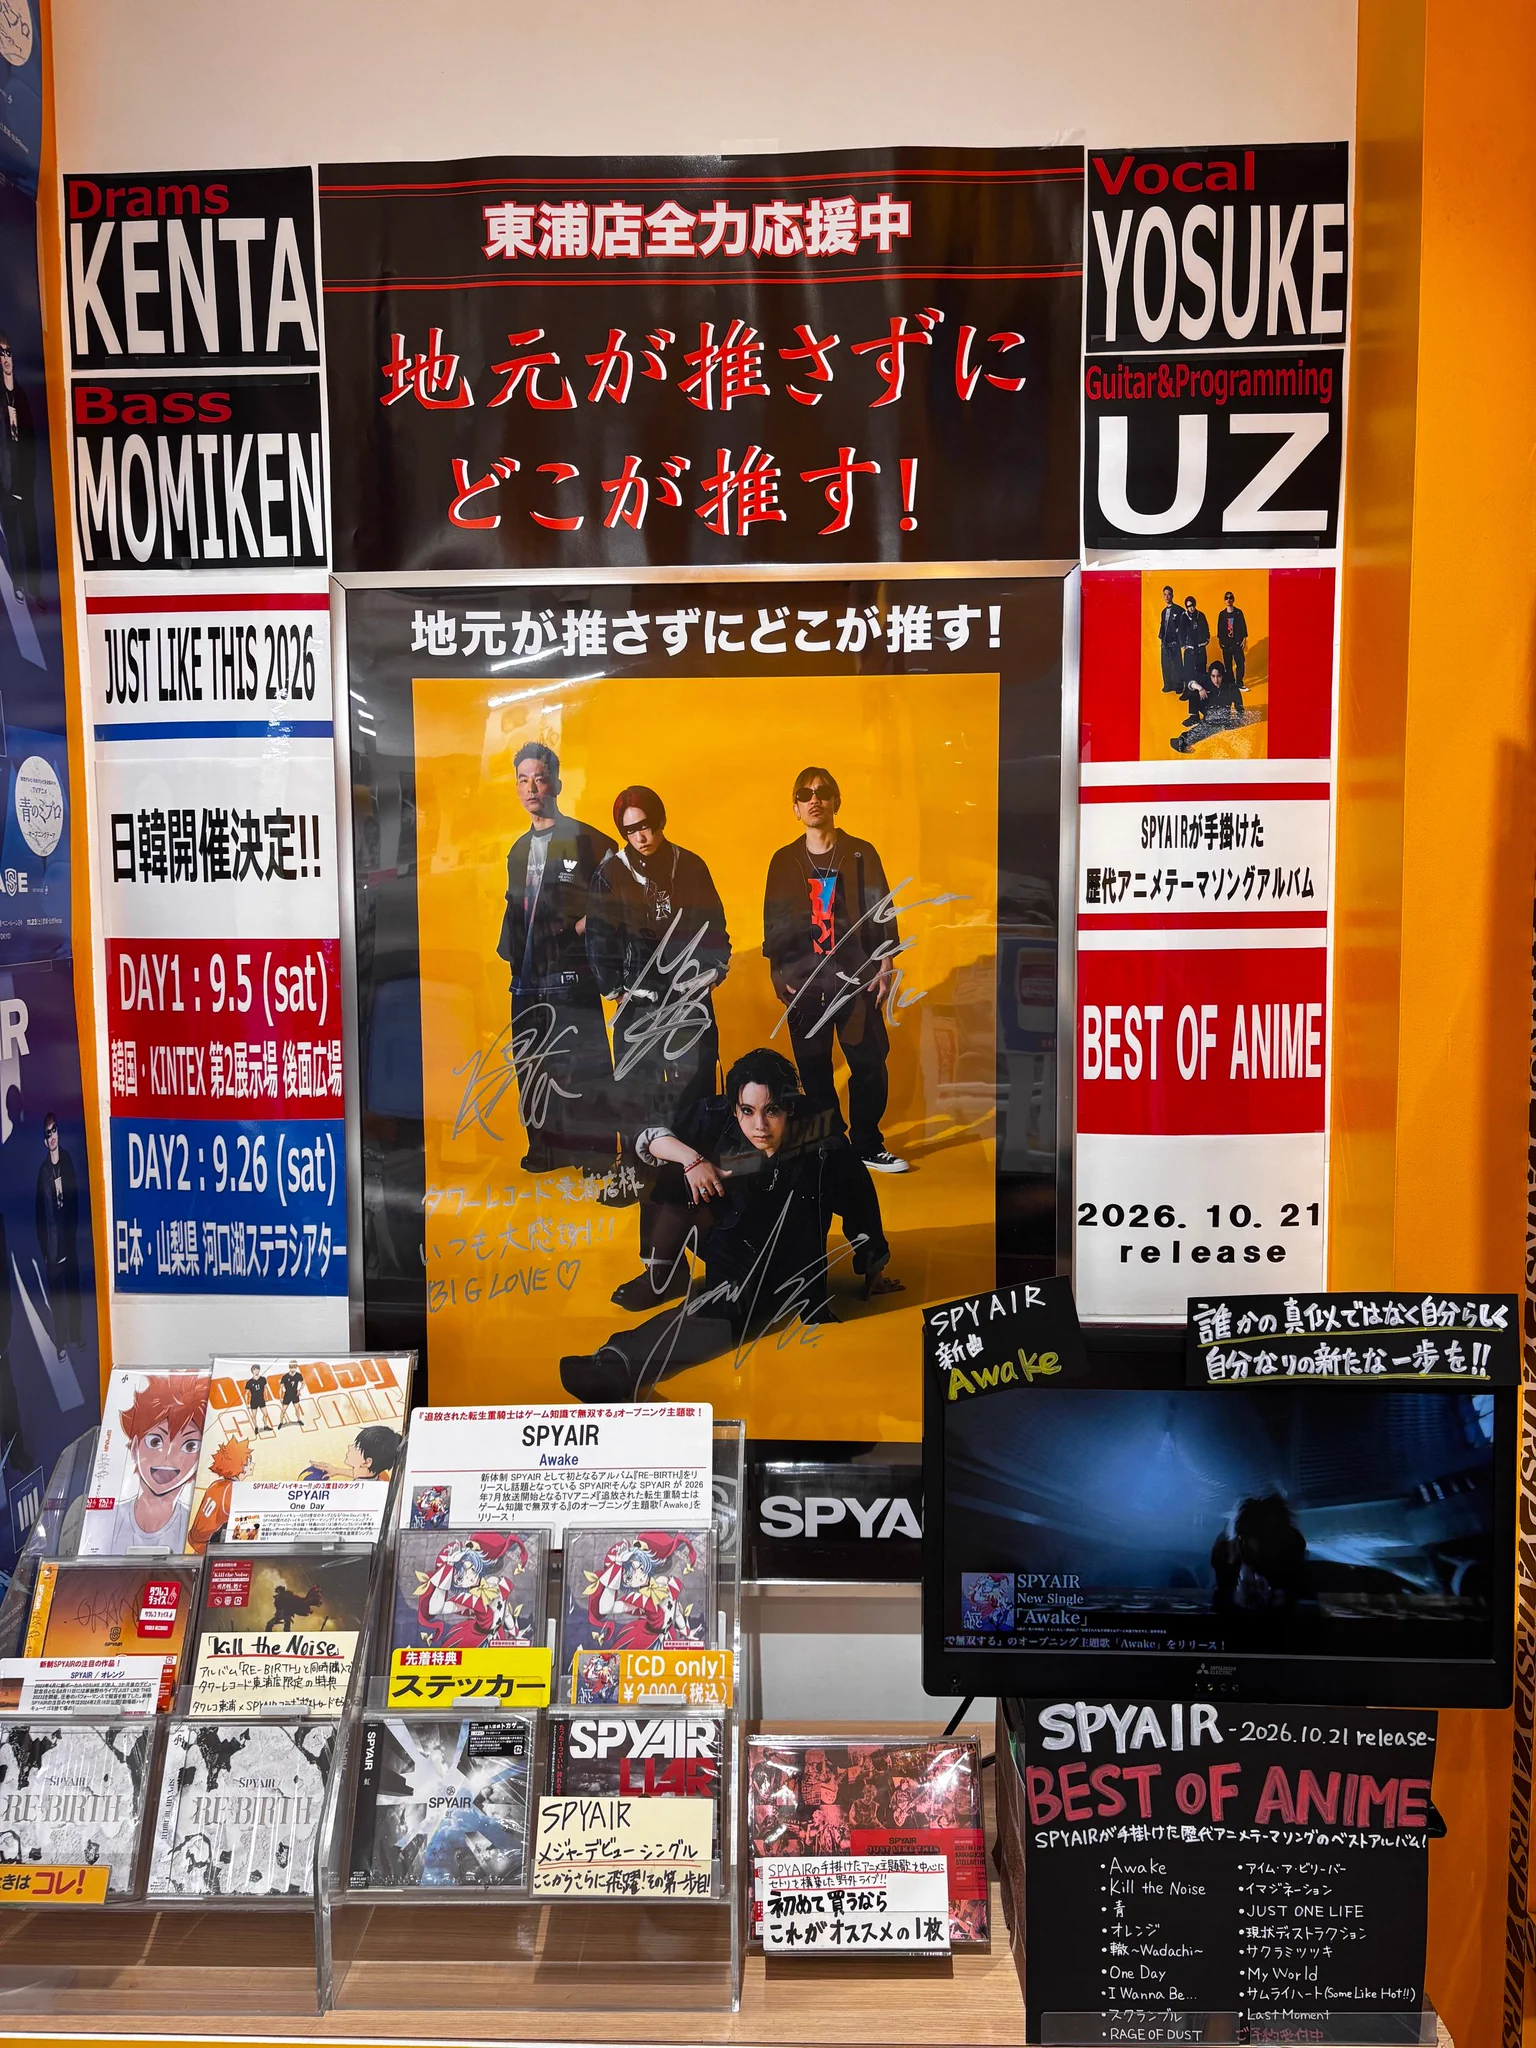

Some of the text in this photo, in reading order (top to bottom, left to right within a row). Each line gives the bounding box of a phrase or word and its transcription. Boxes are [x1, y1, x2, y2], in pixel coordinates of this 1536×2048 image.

[1092, 150, 1256, 196] Vocal
[69, 180, 230, 219] Drams
[483, 194, 912, 260] 東浦店全力応援中
[69, 216, 318, 356] KENTA
[1092, 203, 1345, 345] YOSUKE
[380, 307, 1028, 412] 地元が推さずに
[1085, 360, 1334, 405] Guitar&Programming
[75, 386, 232, 426] Bass
[1097, 411, 1330, 536] UZ
[77, 432, 325, 564] MOMIKEN
[448, 444, 919, 537] どこが推す!
[411, 605, 1001, 658] 地元が推さずにどこが推す!
[104, 624, 316, 704] JUST LIKE THIS 2026
[19, 797, 62, 823] 青のミブロ
[110, 806, 321, 883] 日韓開催決定!!
[1141, 812, 1264, 851] SPYAIRが手掛けた
[1086, 865, 1315, 904] 歴代アニメテーマソングアルバム
[263, 951, 328, 1027] (sat)
[1083, 1003, 1322, 1080] BEST OF ANIME
[209, 1040, 278, 1099] 第2展示場
[282, 1039, 342, 1099] 後面広場
[277, 1133, 336, 1207] (sat)
[1280, 1202, 1320, 1227] 21
[202, 1220, 347, 1278] 河口湖ステラシアター
[1120, 1240, 1287, 1264] release
[427, 1266, 550, 1314] BIG LOVE
[930, 1284, 1047, 1337] SPYAIR
[1192, 1294, 1509, 1344] 誰かの真似ではなく自分らしく
[934, 1333, 985, 1371] 新曲
[1205, 1338, 1492, 1379] 自分なりの新たな一歩を!!
[948, 1347, 1063, 1401] Awake
[522, 1424, 599, 1447] SPYAIR
[539, 1453, 579, 1467] Awake
[480, 1482, 577, 1492] リースし話題となっている
[640, 1481, 671, 1489] SPYAIR
[673, 1481, 682, 1489] が
[685, 1480, 704, 1489] 2026
[481, 1473, 508, 1482] 新体制
[511, 1473, 541, 1481] SPYAIR
[288, 1490, 330, 1501] SPYAIR
[290, 1502, 325, 1511] One Day
[759, 1495, 923, 1539] SPYA
[149, 1587, 169, 1596] タワレコ
[1017, 1574, 1081, 1589] SPYAIR
[148, 1596, 167, 1605] チョイス
[1017, 1593, 1084, 1606] New Single
[1016, 1608, 1088, 1626] 「Awake」
[251, 1636, 281, 1655] the
[405, 1652, 458, 1666] 先着特典
[627, 1654, 726, 1680] [CD only]
[101, 1671, 125, 1679] オレンジ
[392, 1674, 546, 1699] ステッカー
[569, 1719, 717, 1759] SPYAIR
[1038, 1701, 1224, 1754] SPYAIR
[364, 1731, 377, 1771] SPYAIR
[49, 1775, 88, 1787] SPYAIR
[238, 1776, 276, 1788] SPYAIR
[619, 1757, 716, 1797] LIAR
[428, 1797, 472, 1808] SPYAIR
[1025, 1762, 1431, 1829] BEST OF ANIME
[541, 1800, 632, 1834] SPYAIR
[1109, 1857, 1168, 1875] Awake
[1110, 1878, 1206, 1896] Kill the Noise
[1246, 1882, 1333, 1897] イマジネーション
[767, 1890, 888, 1918] 初めて買うなら
[1113, 1900, 1126, 1917] 青
[1246, 1905, 1364, 1918] JUST ONE LIFE
[769, 1916, 945, 1945] これがオススメの1枚
[1111, 1922, 1160, 1938] オレンジ
[1246, 1925, 1367, 1941] 現状ディストラクション
[1246, 1944, 1333, 1960] サクラミツツキ
[1110, 1964, 1166, 1982] One Day
[1247, 1965, 1318, 1982] My World
[1108, 1986, 1116, 1999] I
[1120, 1987, 1165, 2000] Wanna
[1354, 1986, 1377, 1998] Like
[1109, 2007, 1182, 2023] スクランブル
[1247, 2008, 1331, 2021] Last Moment
[1110, 2028, 1203, 2041] RAGE OF DUST
